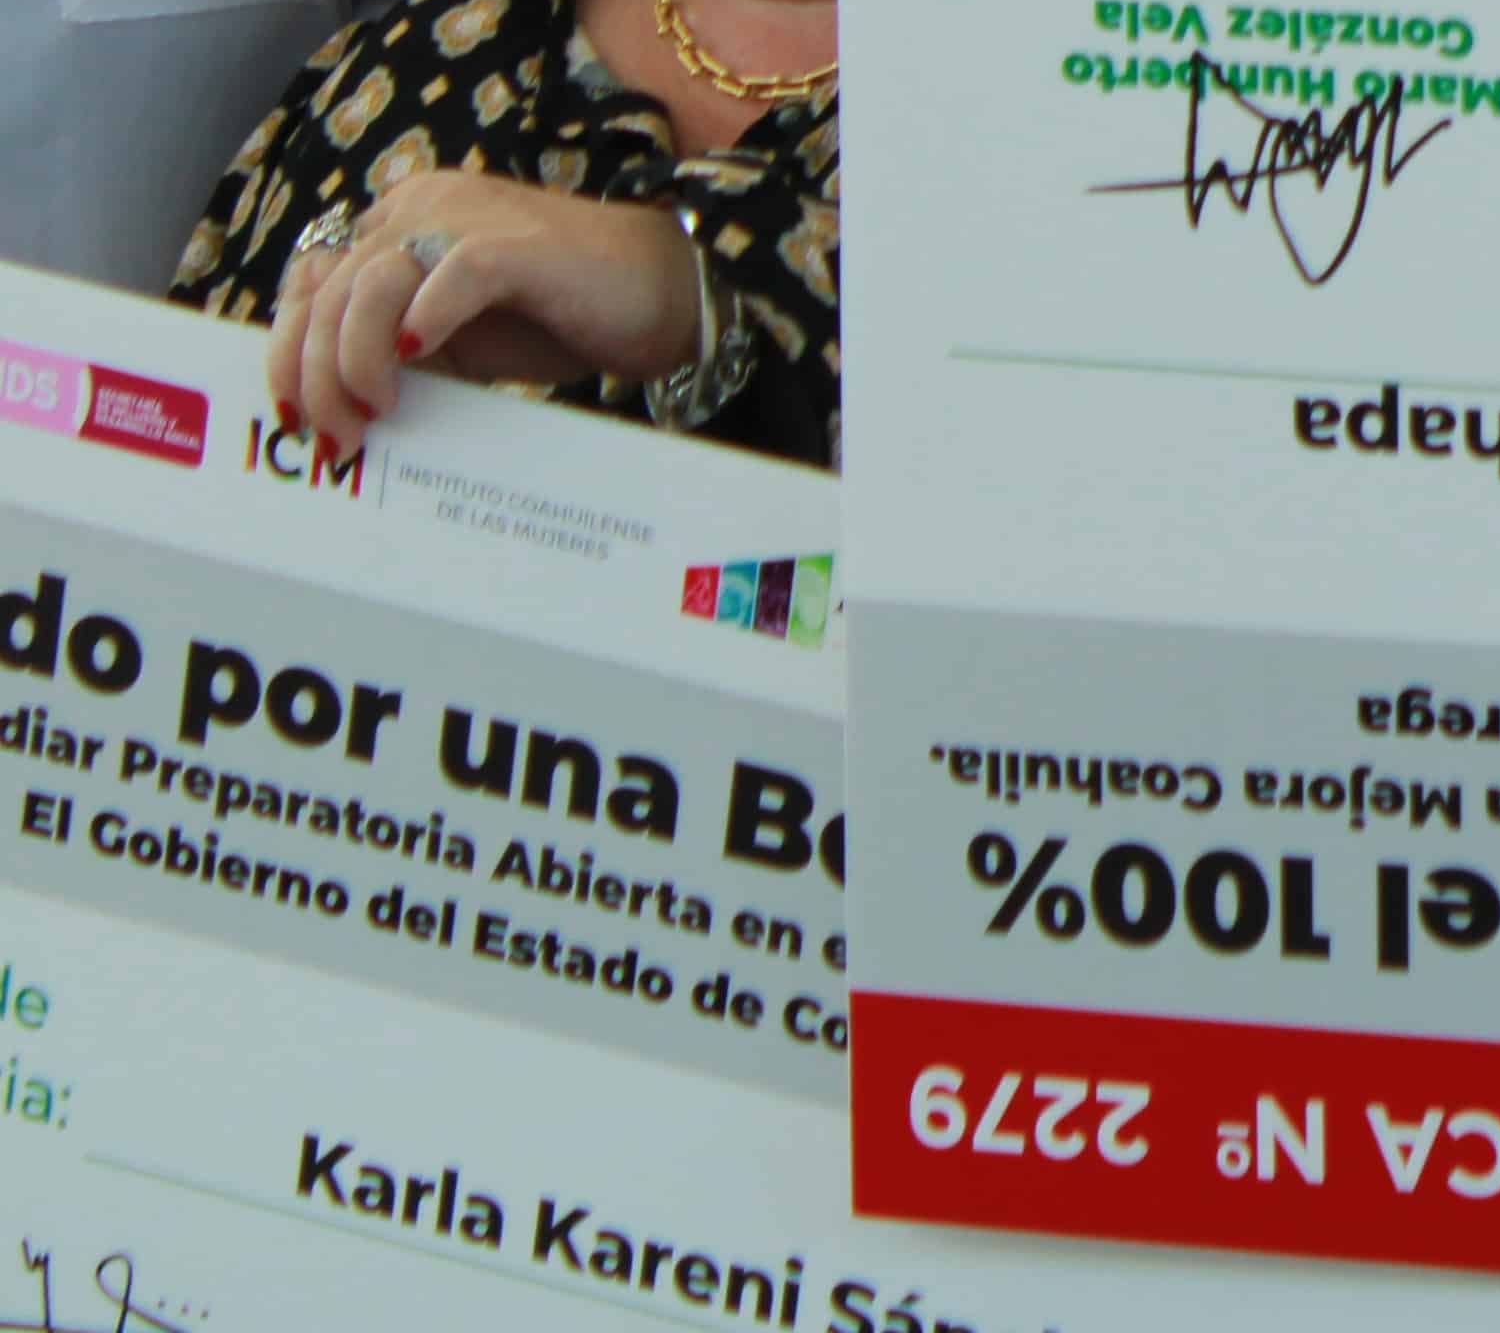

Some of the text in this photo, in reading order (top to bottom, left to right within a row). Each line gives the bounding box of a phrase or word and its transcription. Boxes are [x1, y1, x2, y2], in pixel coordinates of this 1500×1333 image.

[1062, 48, 1335, 119] Humberto
[1094, 0, 1474, 60] González Vela
[179, 641, 402, 762] por
[440, 708, 679, 842] una
[930, 745, 1223, 812] Coahuila.
[1244, 765, 1462, 830] Mejora
[119, 742, 476, 873] Preparatoria
[492, 841, 714, 935] Abierta
[731, 910, 803, 959] en
[968, 832, 1330, 959] 100%
[22, 791, 73, 842] El
[88, 808, 350, 920] Gobierno
[367, 886, 457, 946] del
[473, 911, 674, 1006] Estado
[692, 973, 764, 1027] de
[909, 1066, 1150, 1166] 2279
[298, 1134, 504, 1248] Karla
[533, 1199, 804, 1328] Kareni
